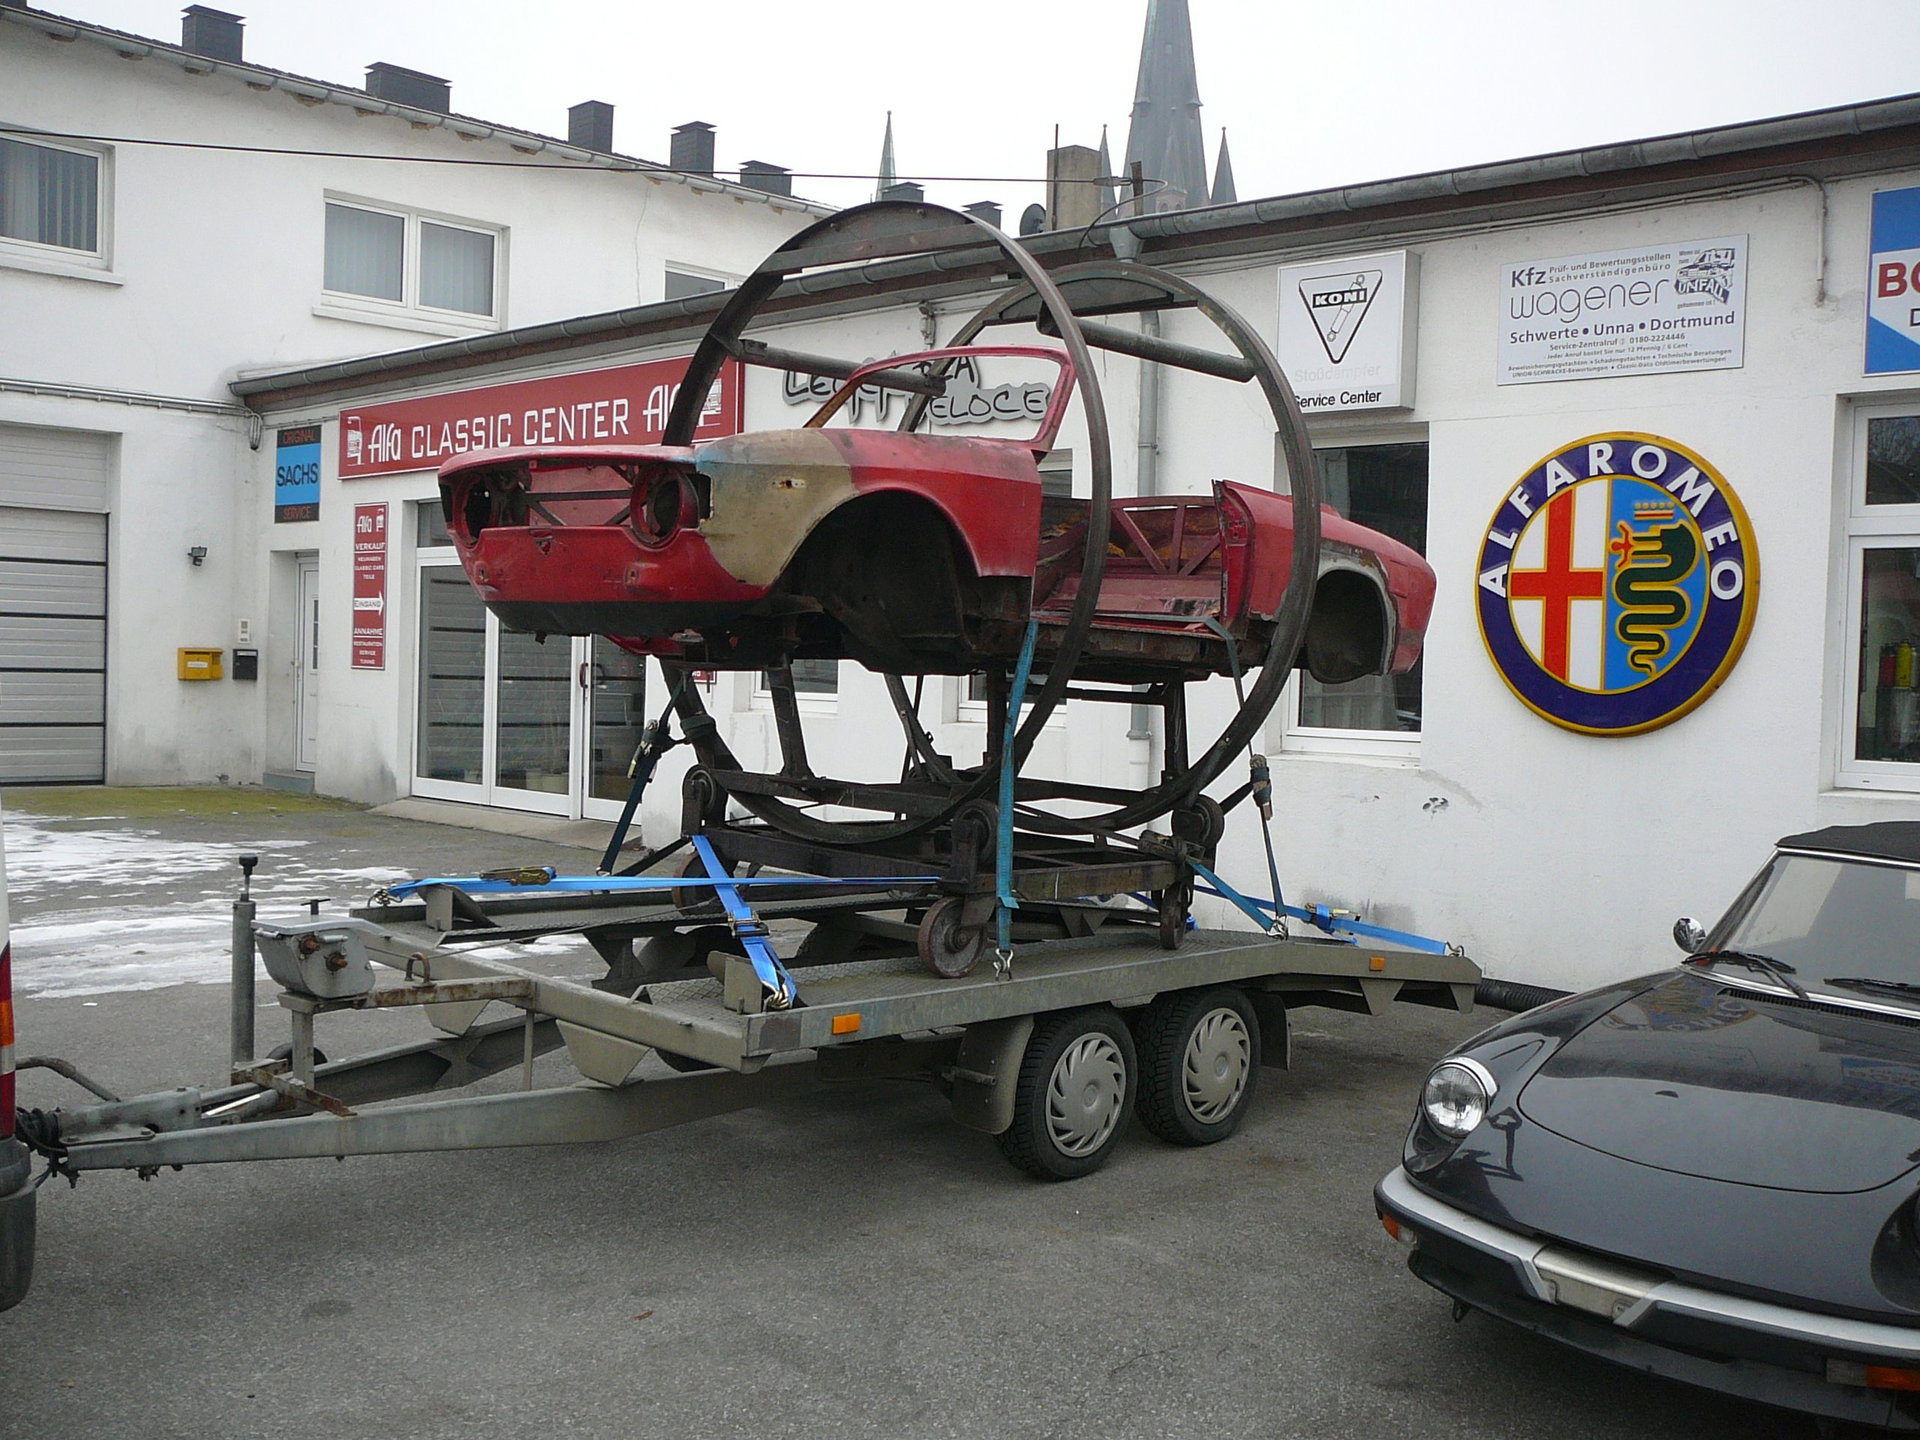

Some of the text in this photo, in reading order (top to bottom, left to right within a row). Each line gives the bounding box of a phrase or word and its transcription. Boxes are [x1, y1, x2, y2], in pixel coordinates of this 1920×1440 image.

[1549, 253, 1671, 274] Prüf- und Bewertungsstellen
[1549, 263, 1671, 283] Sachverständigenbüro
[1511, 267, 1547, 288] Kfz
[1314, 290, 1365, 306] KONI
[1510, 279, 1670, 324] wagener
[1678, 278, 1725, 304] UNFALL
[1510, 311, 1735, 344] Schwerte Unna Dortmund
[1549, 338, 1617, 351] Service-Zentralruf
[1340, 390, 1382, 405] Center
[368, 423, 401, 464] Alfa
[411, 413, 512, 459] CLASSIC
[523, 398, 629, 446] CENTER
[276, 462, 318, 487] SACHS
[1479, 441, 1744, 600] ALFA ROMEO
[355, 542, 385, 550] VERKAUF
[354, 627, 383, 635] ANNAHME
